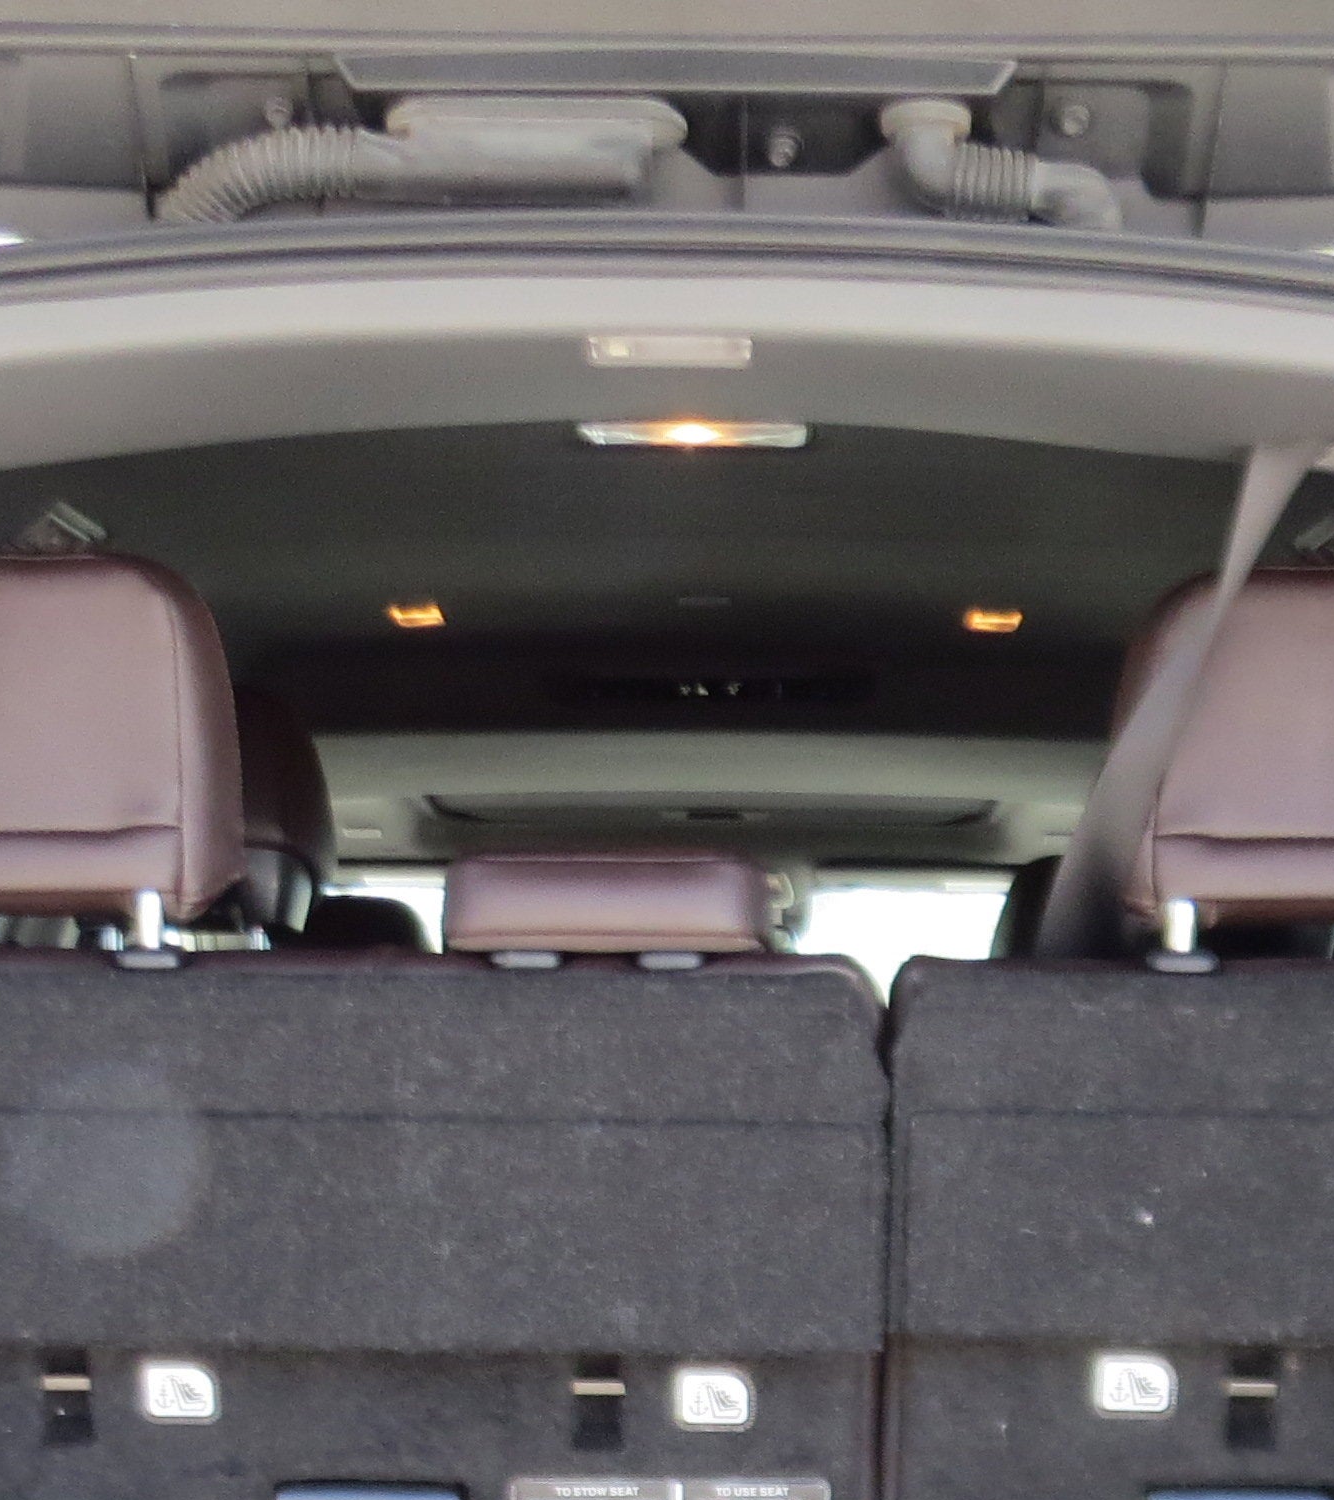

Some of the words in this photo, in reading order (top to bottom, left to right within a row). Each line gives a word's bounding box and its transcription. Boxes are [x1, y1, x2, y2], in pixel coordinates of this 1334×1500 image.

[556, 1487, 571, 1497] TO
[573, 1487, 608, 1497] STOW
[610, 1487, 640, 1497] SEAT
[716, 1487, 732, 1497] TO
[734, 1487, 757, 1497] USE
[760, 1487, 789, 1497] SEAT
